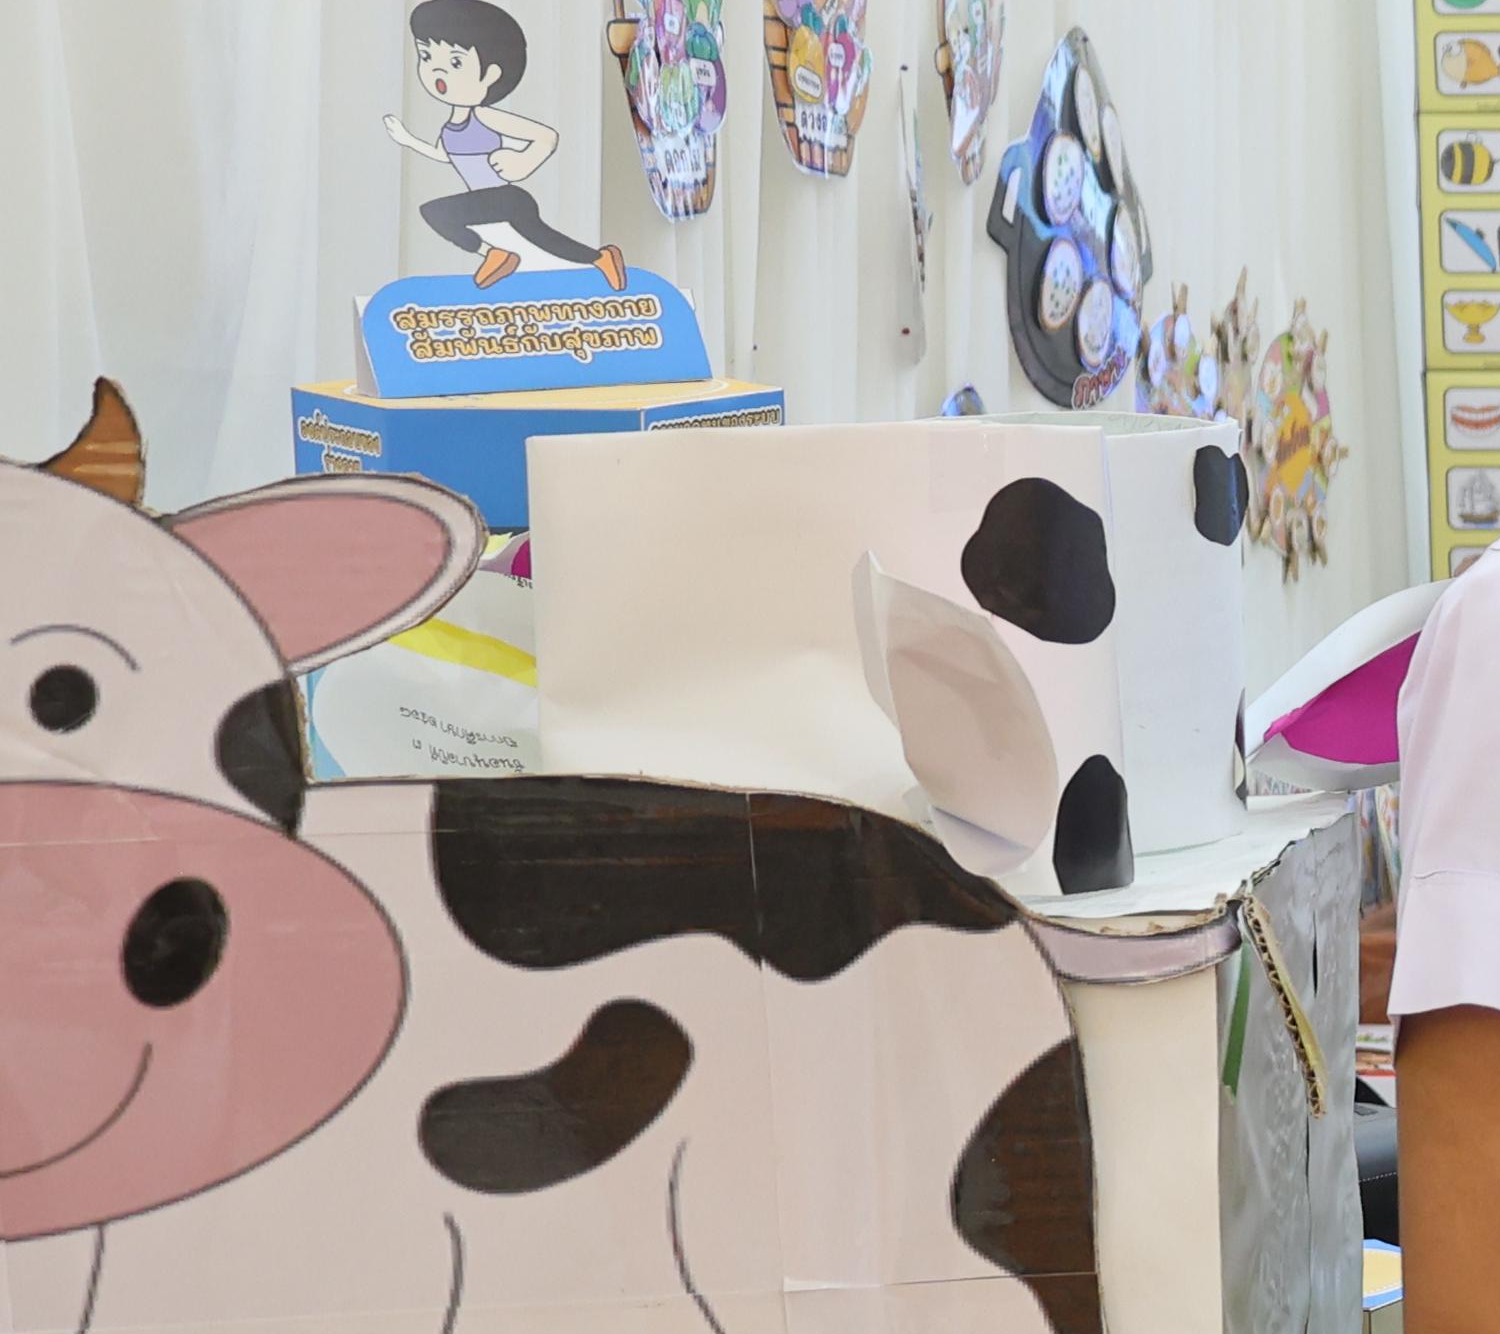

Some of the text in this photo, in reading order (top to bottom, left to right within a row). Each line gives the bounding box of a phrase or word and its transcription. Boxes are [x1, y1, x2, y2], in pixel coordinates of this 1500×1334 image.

[395, 297, 657, 331] สมรรถภาพทางกาย
[409, 324, 658, 360] สัมพันธ์กับสุขภาพ
